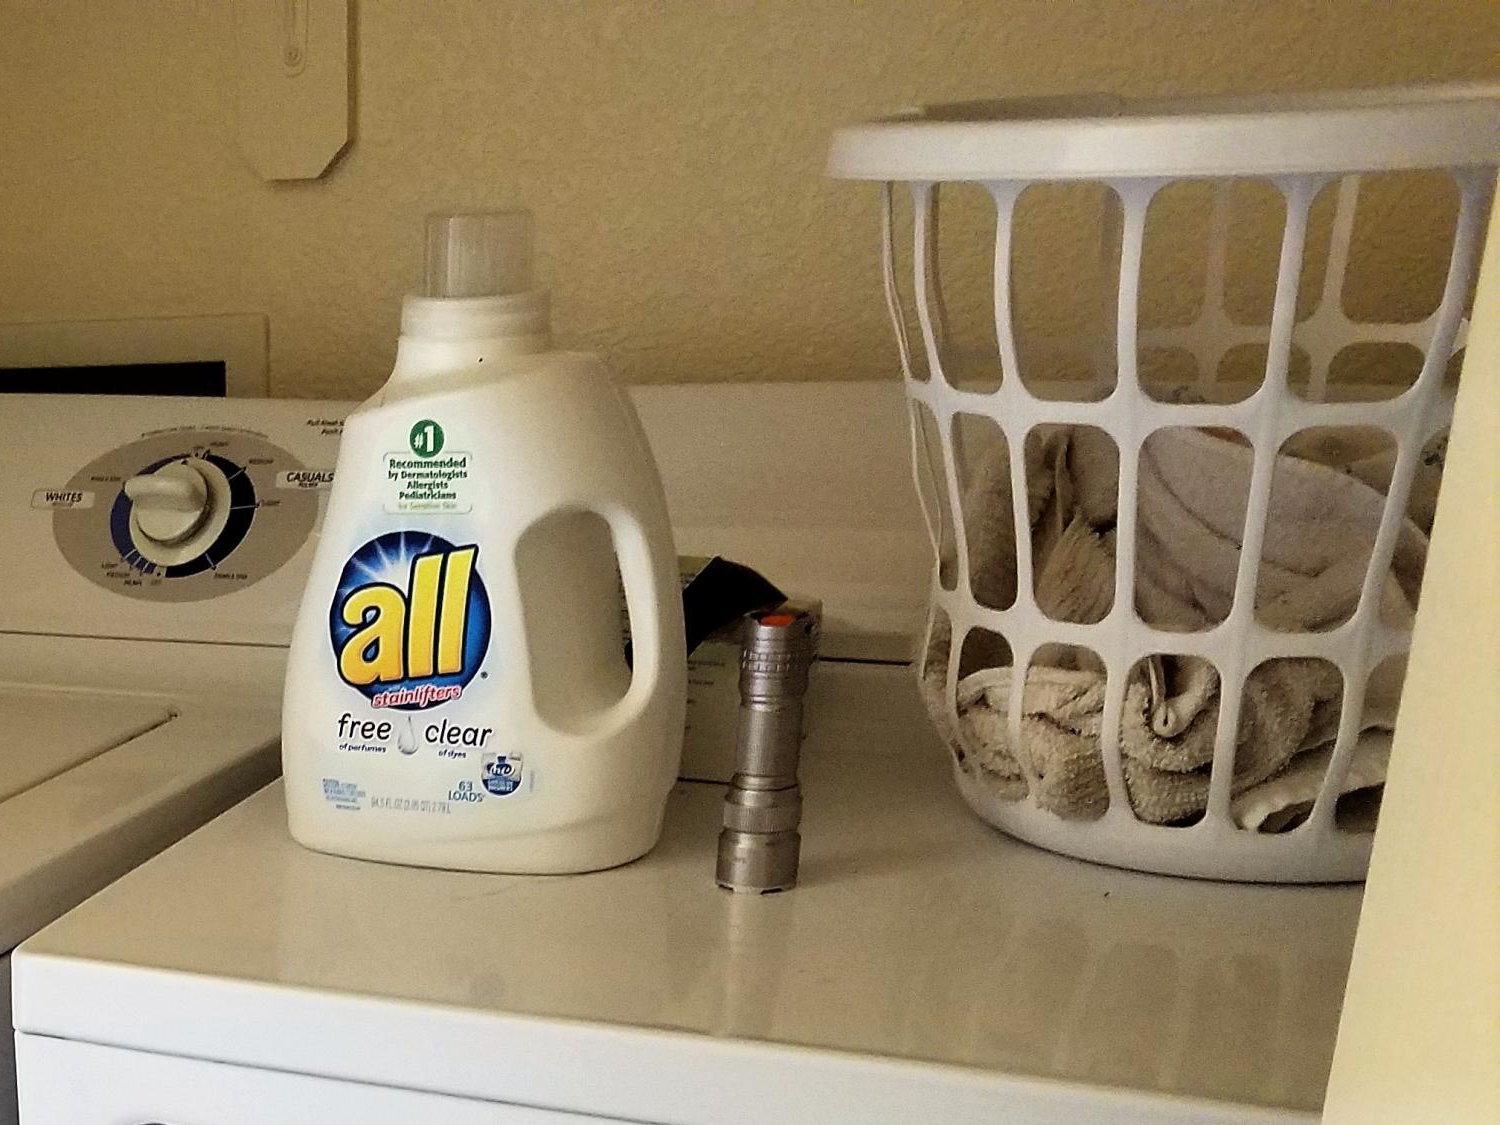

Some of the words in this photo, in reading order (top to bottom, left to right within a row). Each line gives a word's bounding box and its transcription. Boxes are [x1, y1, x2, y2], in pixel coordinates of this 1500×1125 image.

[414, 425, 435, 453] #1
[389, 457, 467, 469] Recommended
[286, 471, 335, 483] CASUALS
[388, 471, 399, 481] by
[401, 470, 468, 481] Dermatologists
[406, 481, 449, 493] Allergists
[45, 491, 83, 503] WHITES
[399, 490, 457, 500] Pediatricians
[339, 546, 478, 686] all
[373, 684, 463, 708] stainlifters
[337, 712, 392, 740] free
[424, 718, 493, 747] clear
[339, 742, 348, 751] of
[348, 743, 387, 753] perfumes
[438, 749, 448, 758] of
[448, 750, 467, 759] dyes
[458, 780, 473, 791] 63
[448, 790, 484, 802] LOADS
